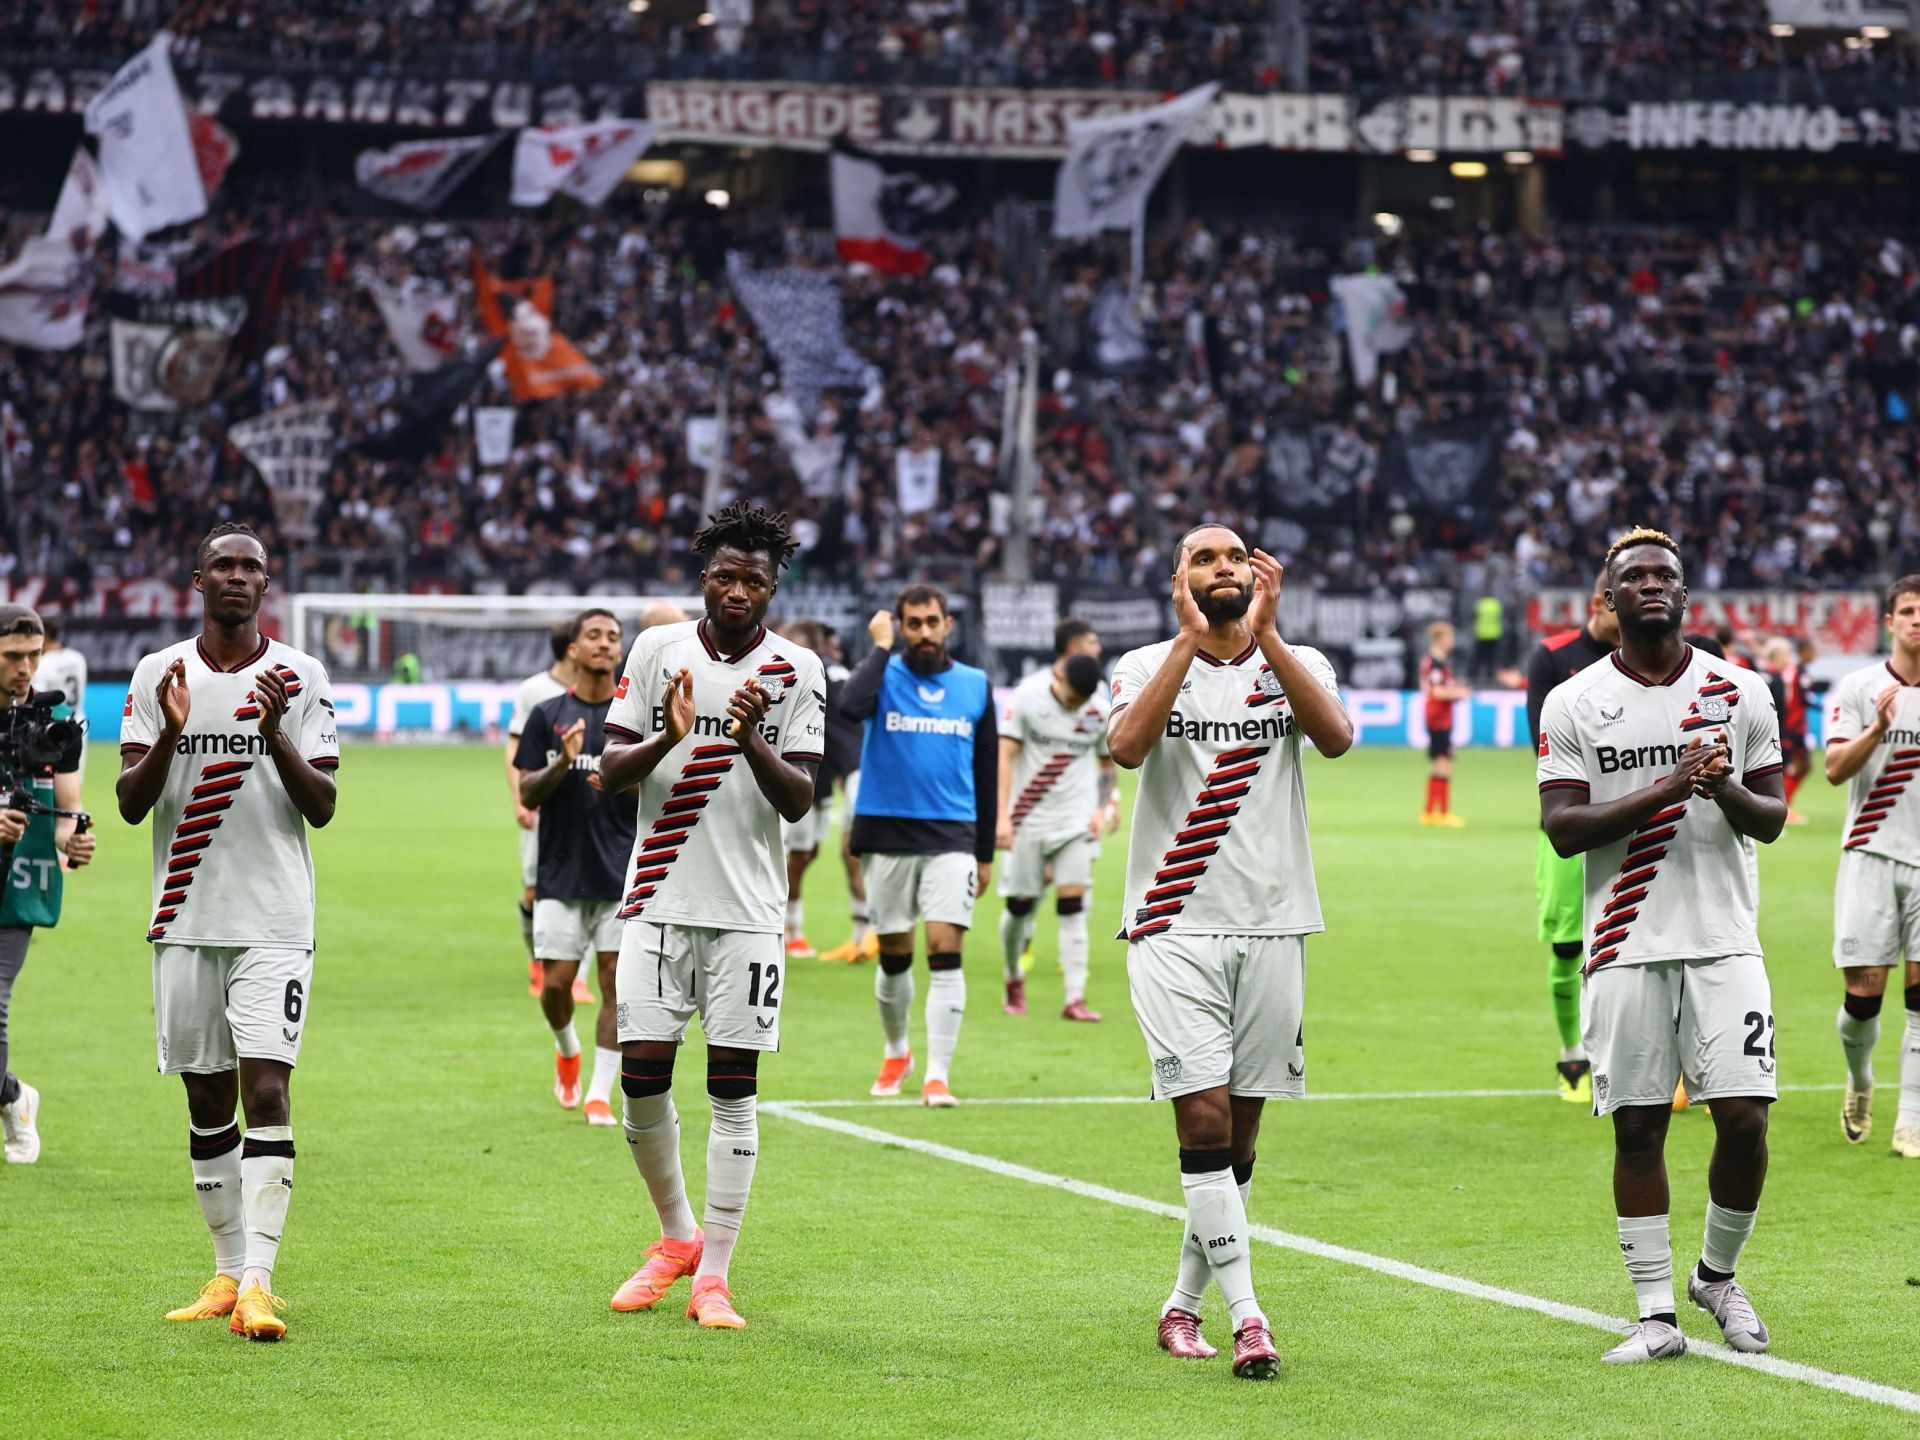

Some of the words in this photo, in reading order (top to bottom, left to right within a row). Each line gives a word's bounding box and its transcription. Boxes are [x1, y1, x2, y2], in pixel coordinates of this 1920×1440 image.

[649, 92, 882, 138] BRIGADE
[1628, 102, 1838, 152] INFERNO
[1166, 710, 1293, 742] Barmenia
[12, 856, 57, 891] ST
[284, 979, 303, 1023] 6
[748, 962, 780, 1008] 12
